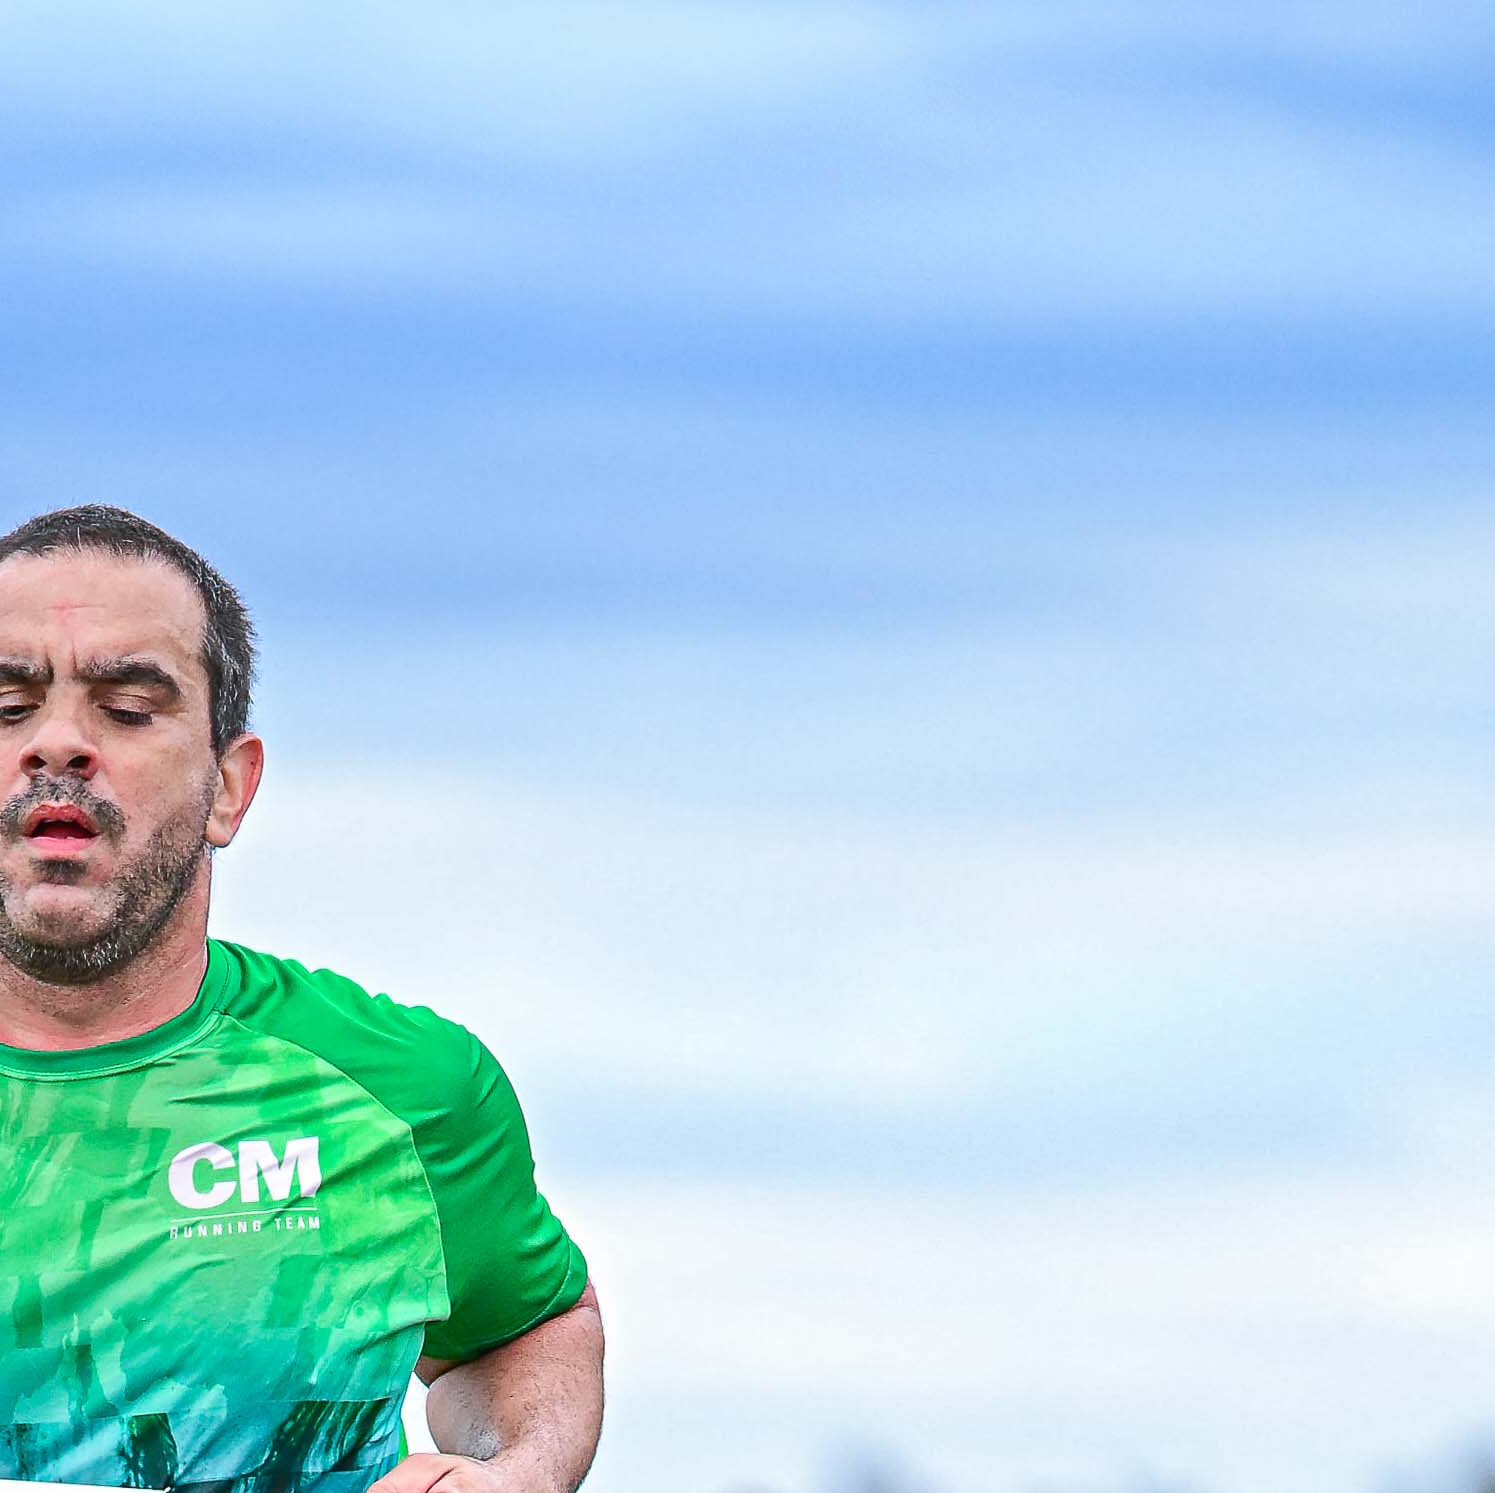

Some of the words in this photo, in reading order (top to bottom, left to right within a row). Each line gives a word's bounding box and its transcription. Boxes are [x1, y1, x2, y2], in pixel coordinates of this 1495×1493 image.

[168, 1136, 322, 1209] CM
[169, 1220, 262, 1239] RUNNING
[274, 1216, 320, 1230] TEAM
